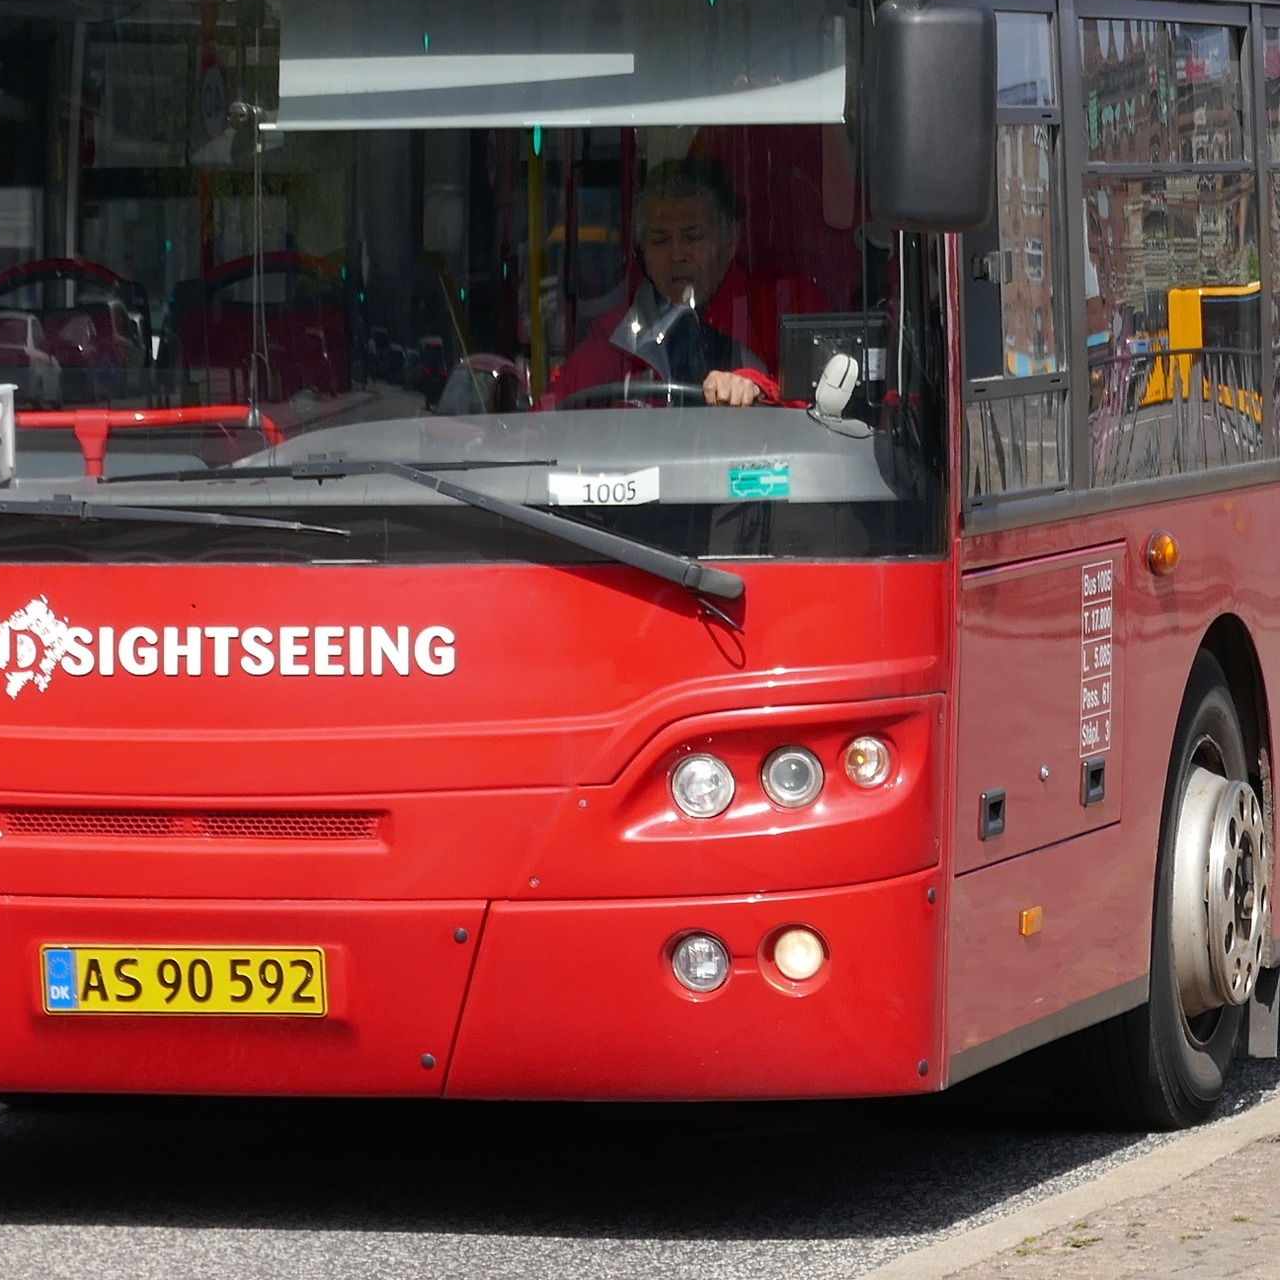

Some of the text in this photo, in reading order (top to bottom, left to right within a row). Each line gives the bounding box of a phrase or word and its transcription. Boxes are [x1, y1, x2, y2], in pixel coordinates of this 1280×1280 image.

[582, 480, 637, 504] 1005
[1083, 570, 1111, 597] Bus 1005
[1102, 681, 1110, 705] 61
[50, 985, 71, 1000] DK
[81, 958, 316, 1005] AS 90 592
